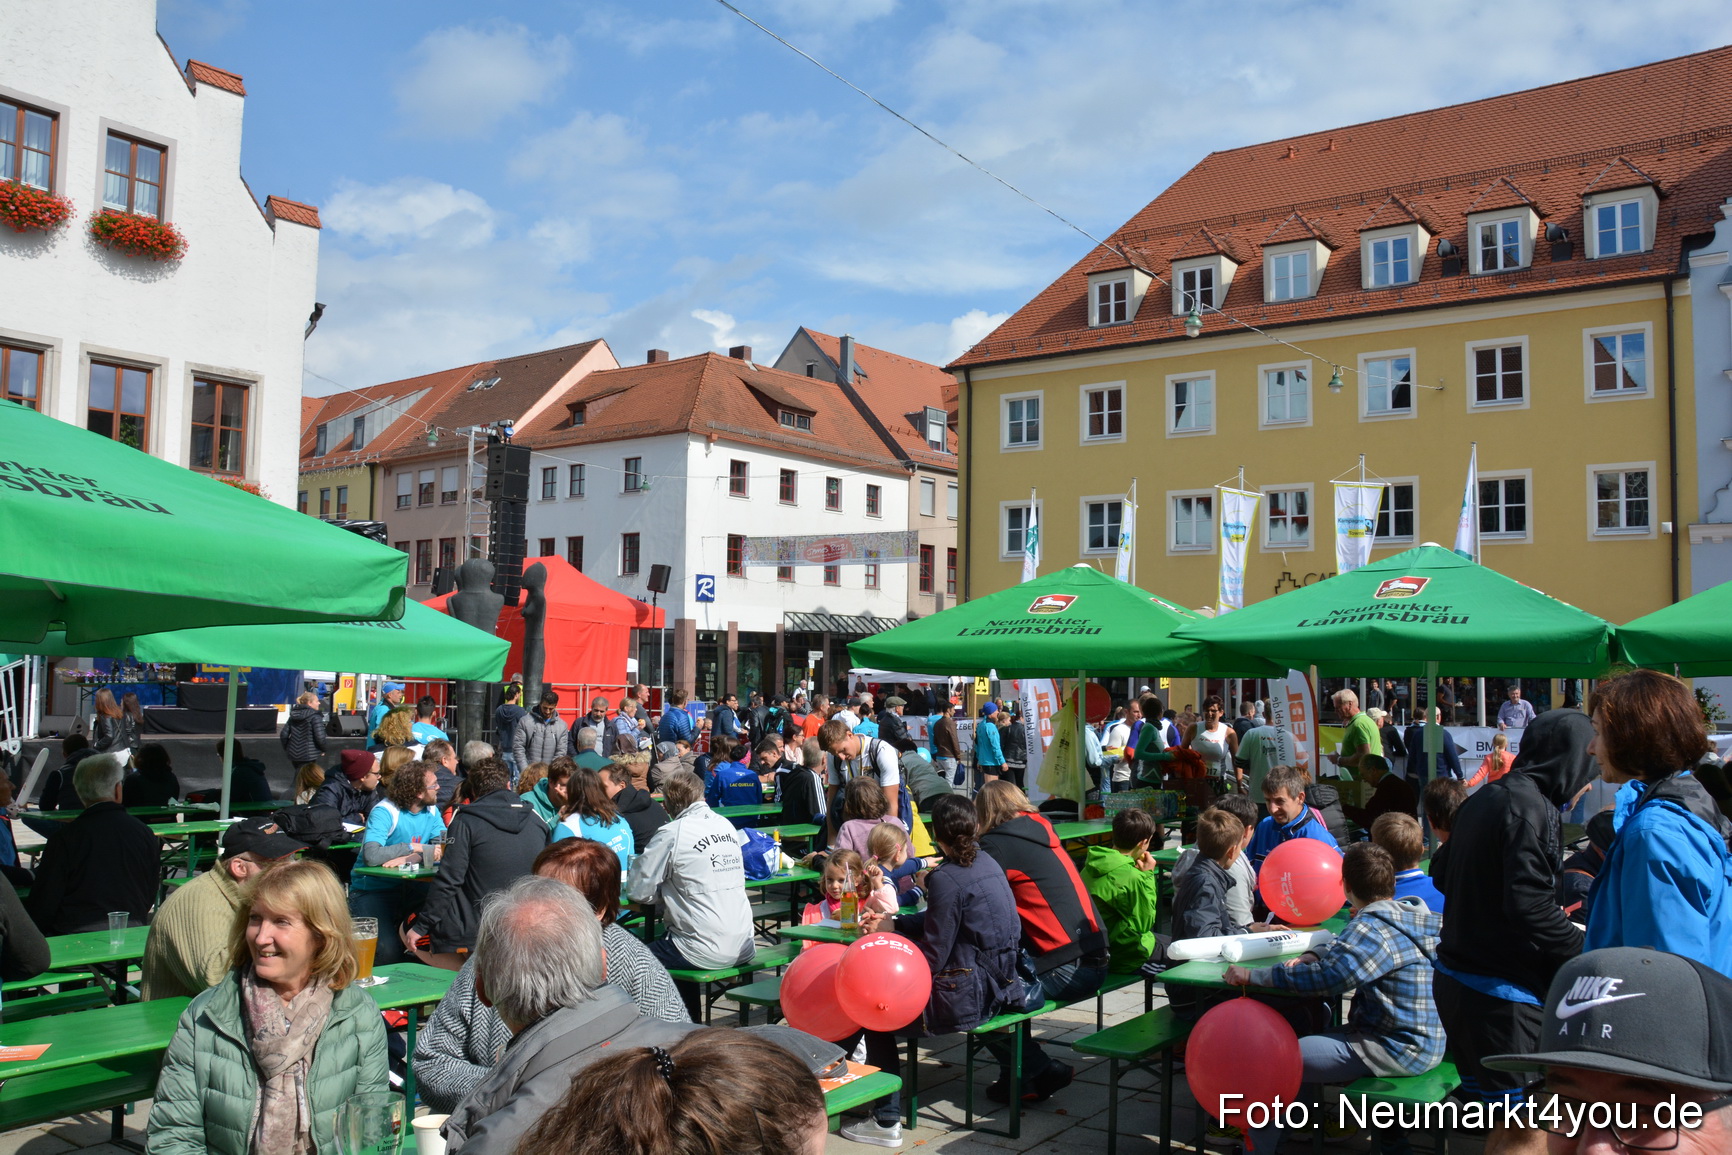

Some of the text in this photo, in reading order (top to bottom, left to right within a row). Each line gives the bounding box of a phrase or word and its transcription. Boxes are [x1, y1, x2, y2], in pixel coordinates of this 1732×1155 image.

[1328, 603, 1453, 617] Neumarkter
[985, 617, 1091, 627] Neumarkter
[1297, 611, 1470, 628] Lammsbräu
[957, 625, 1102, 637] Lammsbräu
[693, 836, 712, 853] TSV
[861, 936, 914, 951] RÖDL
[1567, 976, 1624, 1000] NIKE
[1558, 1021, 1613, 1039] AIR
